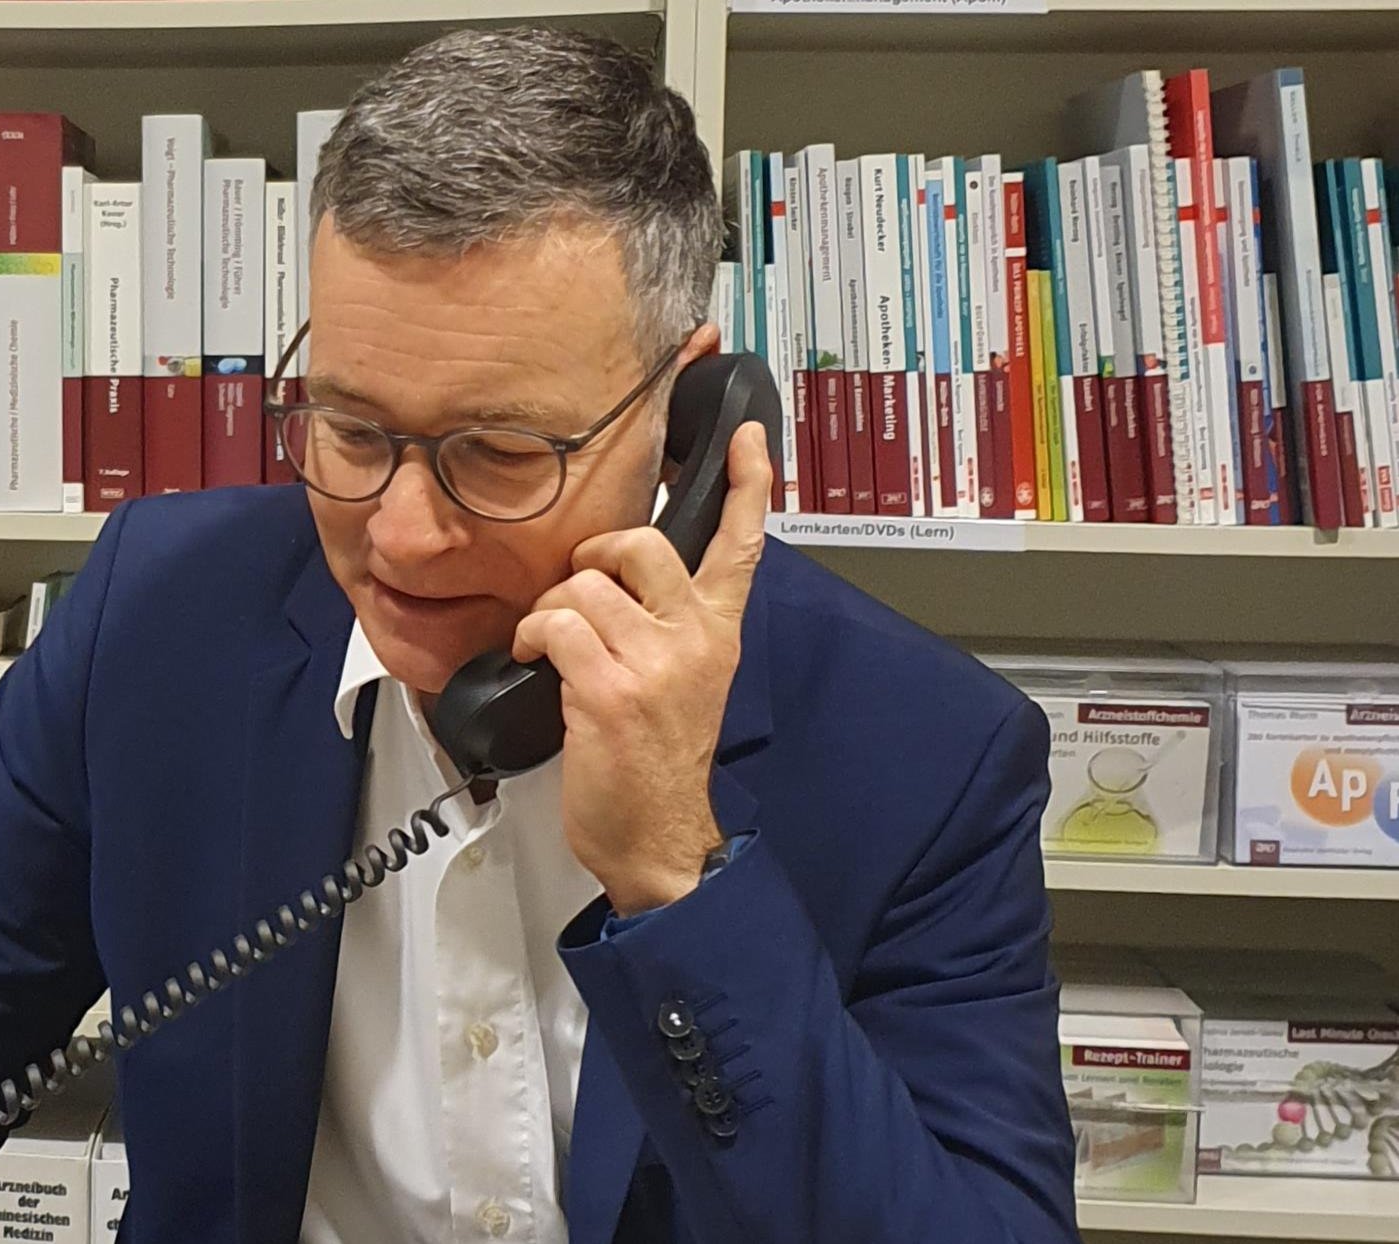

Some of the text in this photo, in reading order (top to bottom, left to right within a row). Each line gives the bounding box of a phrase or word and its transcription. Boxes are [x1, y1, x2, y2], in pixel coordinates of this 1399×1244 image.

[164, 137, 178, 300] Voigt Pharmazeutische Technologie
[817, 167, 832, 282] Apothekenmanagement
[219, 179, 233, 309] Pharmazeutische Technologie
[873, 168, 897, 440] Kurt Neudecker Apotheken- Marketing
[8, 319, 19, 352] Chemie
[108, 277, 121, 414] Pharmazeutische Praxis
[8, 417, 20, 491] Pharmazeutische
[780, 522, 955, 541] Lernkarten/DVDs (Lern)
[1087, 708, 1203, 724] Arzneistoffchemie
[1083, 730, 1161, 746] Hilfsstoffe
[1308, 758, 1367, 812] Ap
[1083, 1050, 1184, 1067] Rezept-Trainer
[1203, 1047, 1300, 1059] harmazeutische
[17, 1195, 41, 1209] der
[3, 1226, 54, 1242] Medizin
